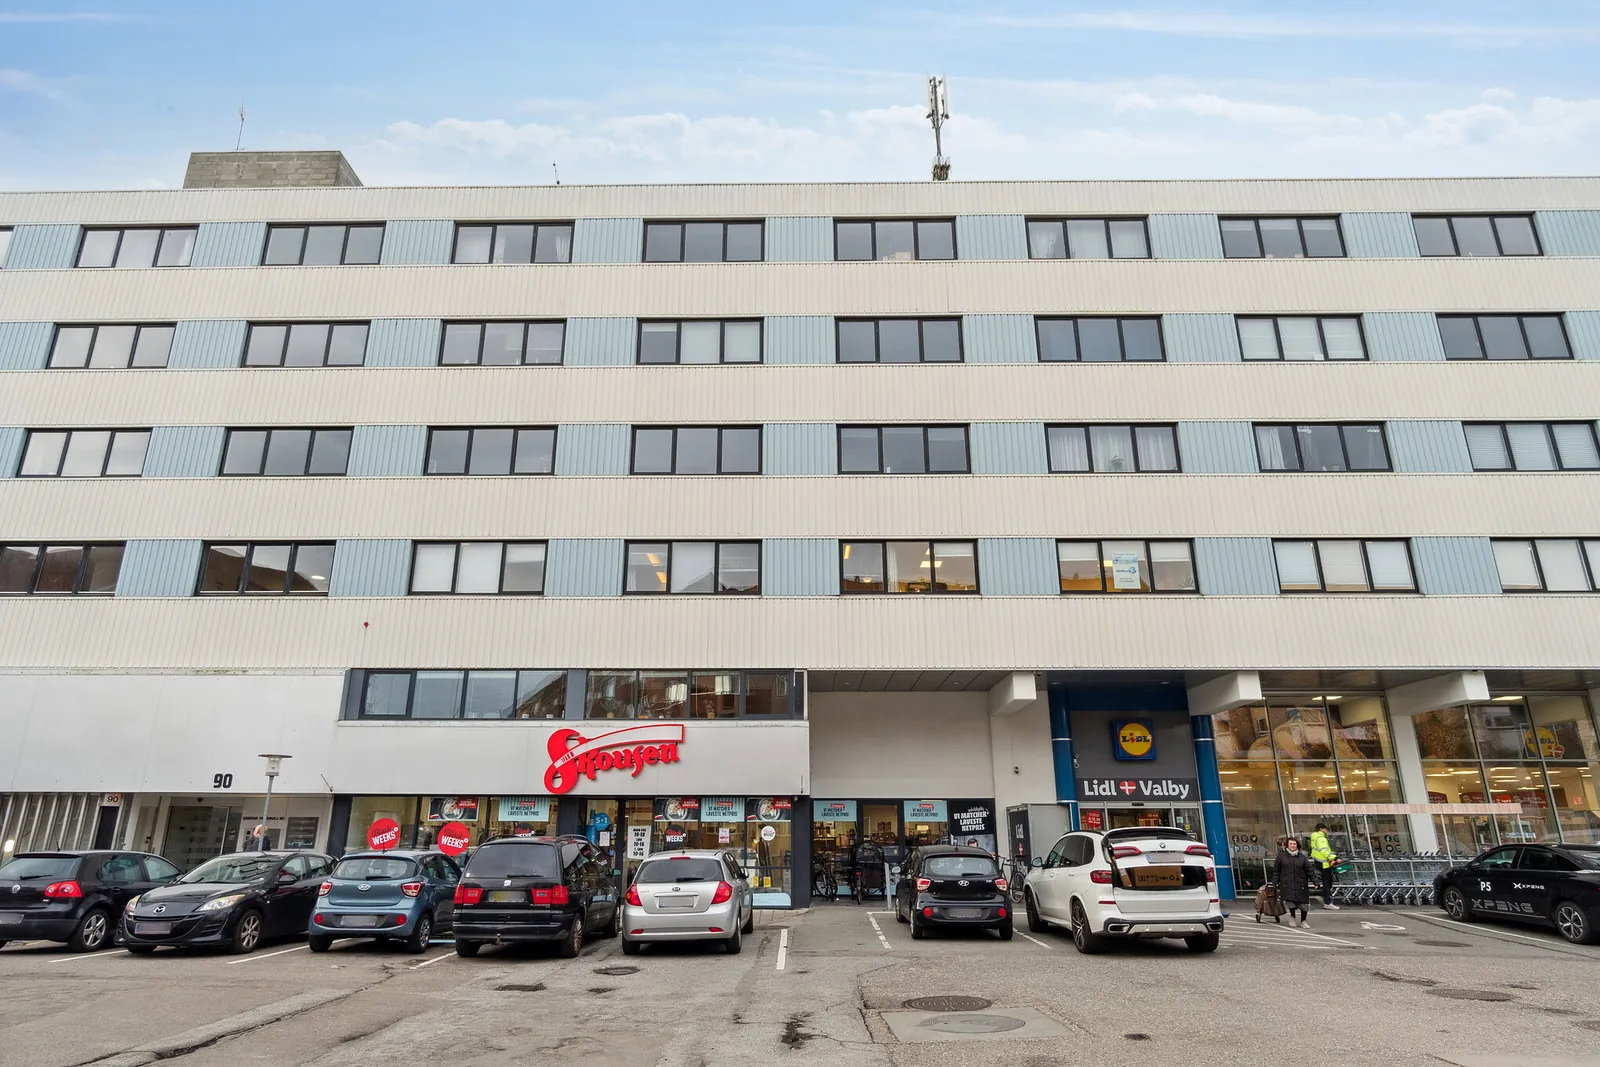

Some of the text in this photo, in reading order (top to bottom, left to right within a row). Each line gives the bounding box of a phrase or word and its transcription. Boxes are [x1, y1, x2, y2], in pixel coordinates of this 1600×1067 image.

[544, 728, 680, 794] Skousen
[213, 773, 233, 788] 90
[1083, 780, 1190, 800] Lidl Valby
[107, 795, 119, 803] 90
[960, 811, 987, 819] MATCHER
[372, 831, 396, 846] WEEKS
[441, 836, 464, 849] WEEKS
[1480, 881, 1492, 892] P5
[1471, 898, 1534, 913] XPENG
